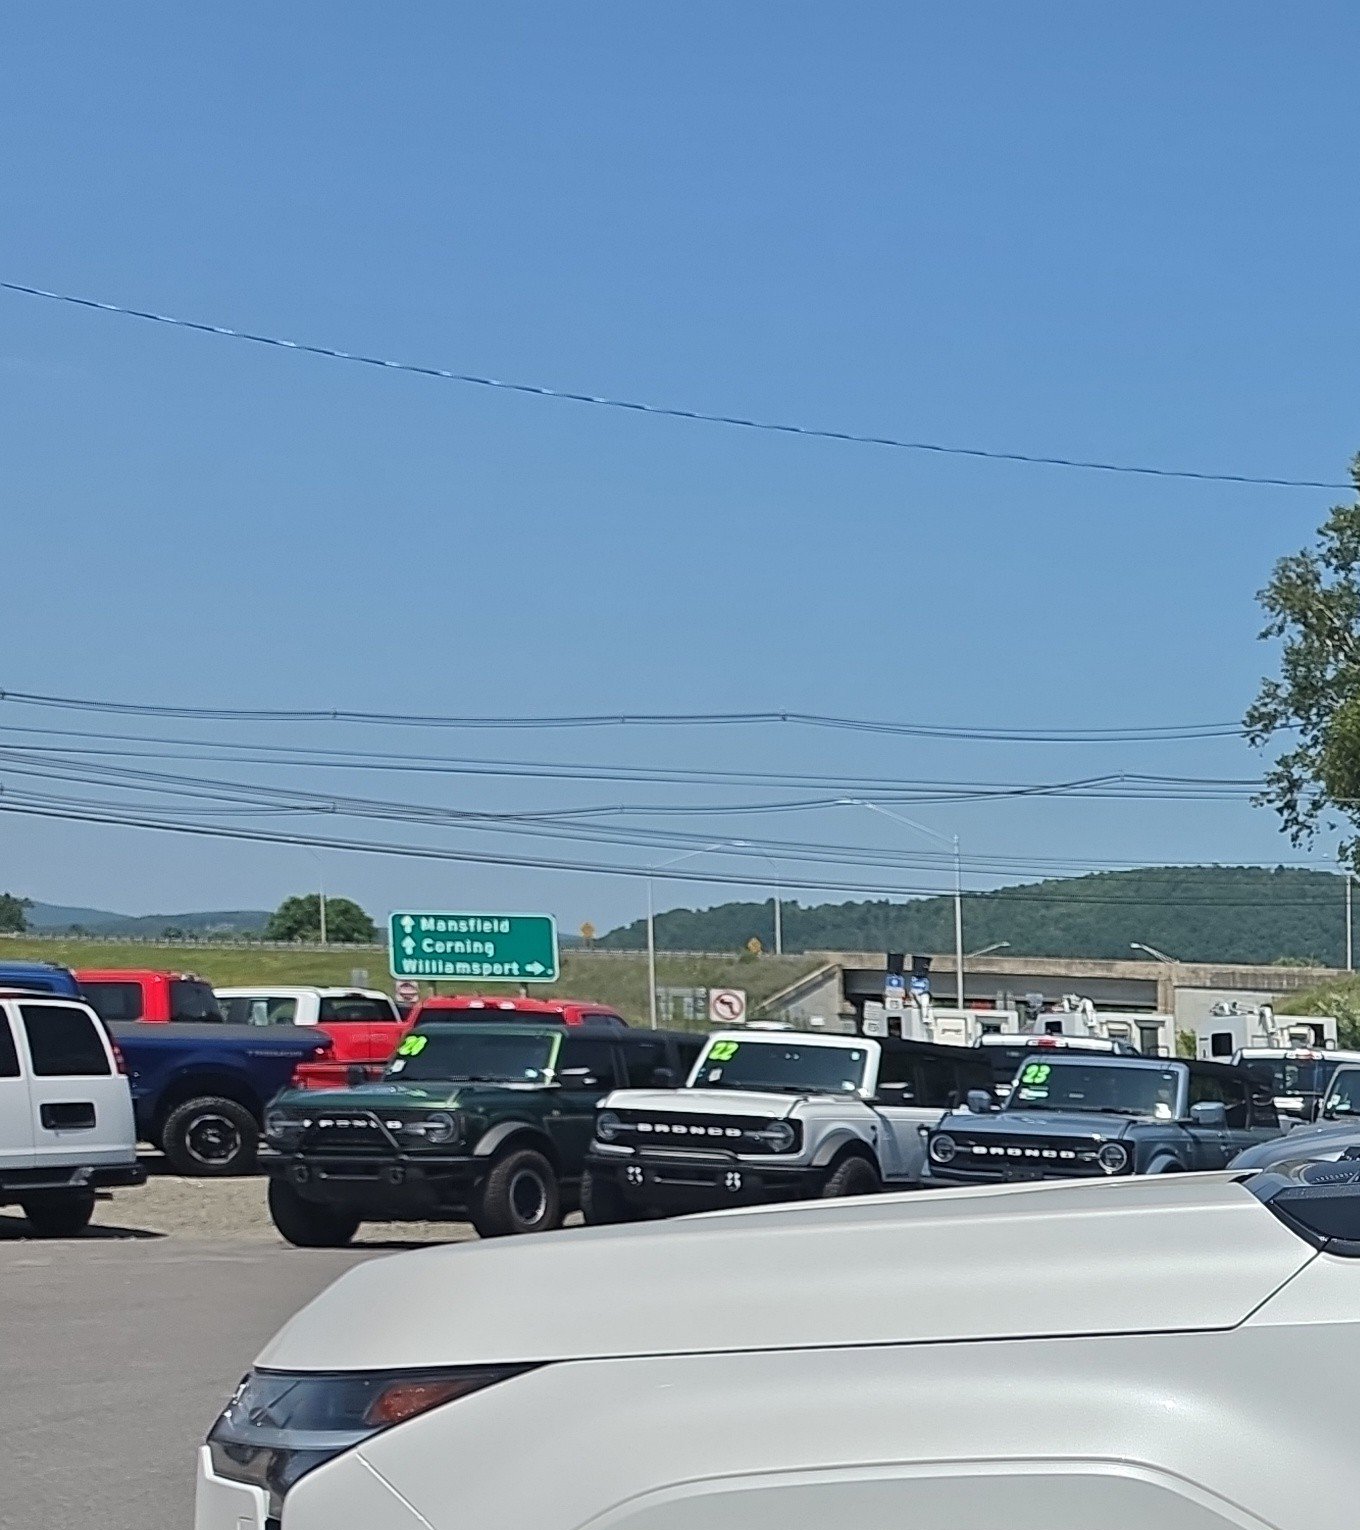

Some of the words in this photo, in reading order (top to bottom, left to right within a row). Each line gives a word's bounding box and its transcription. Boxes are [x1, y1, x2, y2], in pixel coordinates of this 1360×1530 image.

[420, 915, 510, 933] Mansfield
[421, 937, 495, 958] Corning
[402, 957, 520, 976] Williamsport
[708, 1042, 740, 1061] 22
[1022, 1063, 1051, 1084] 23
[972, 1145, 1076, 1159] BRONCO
